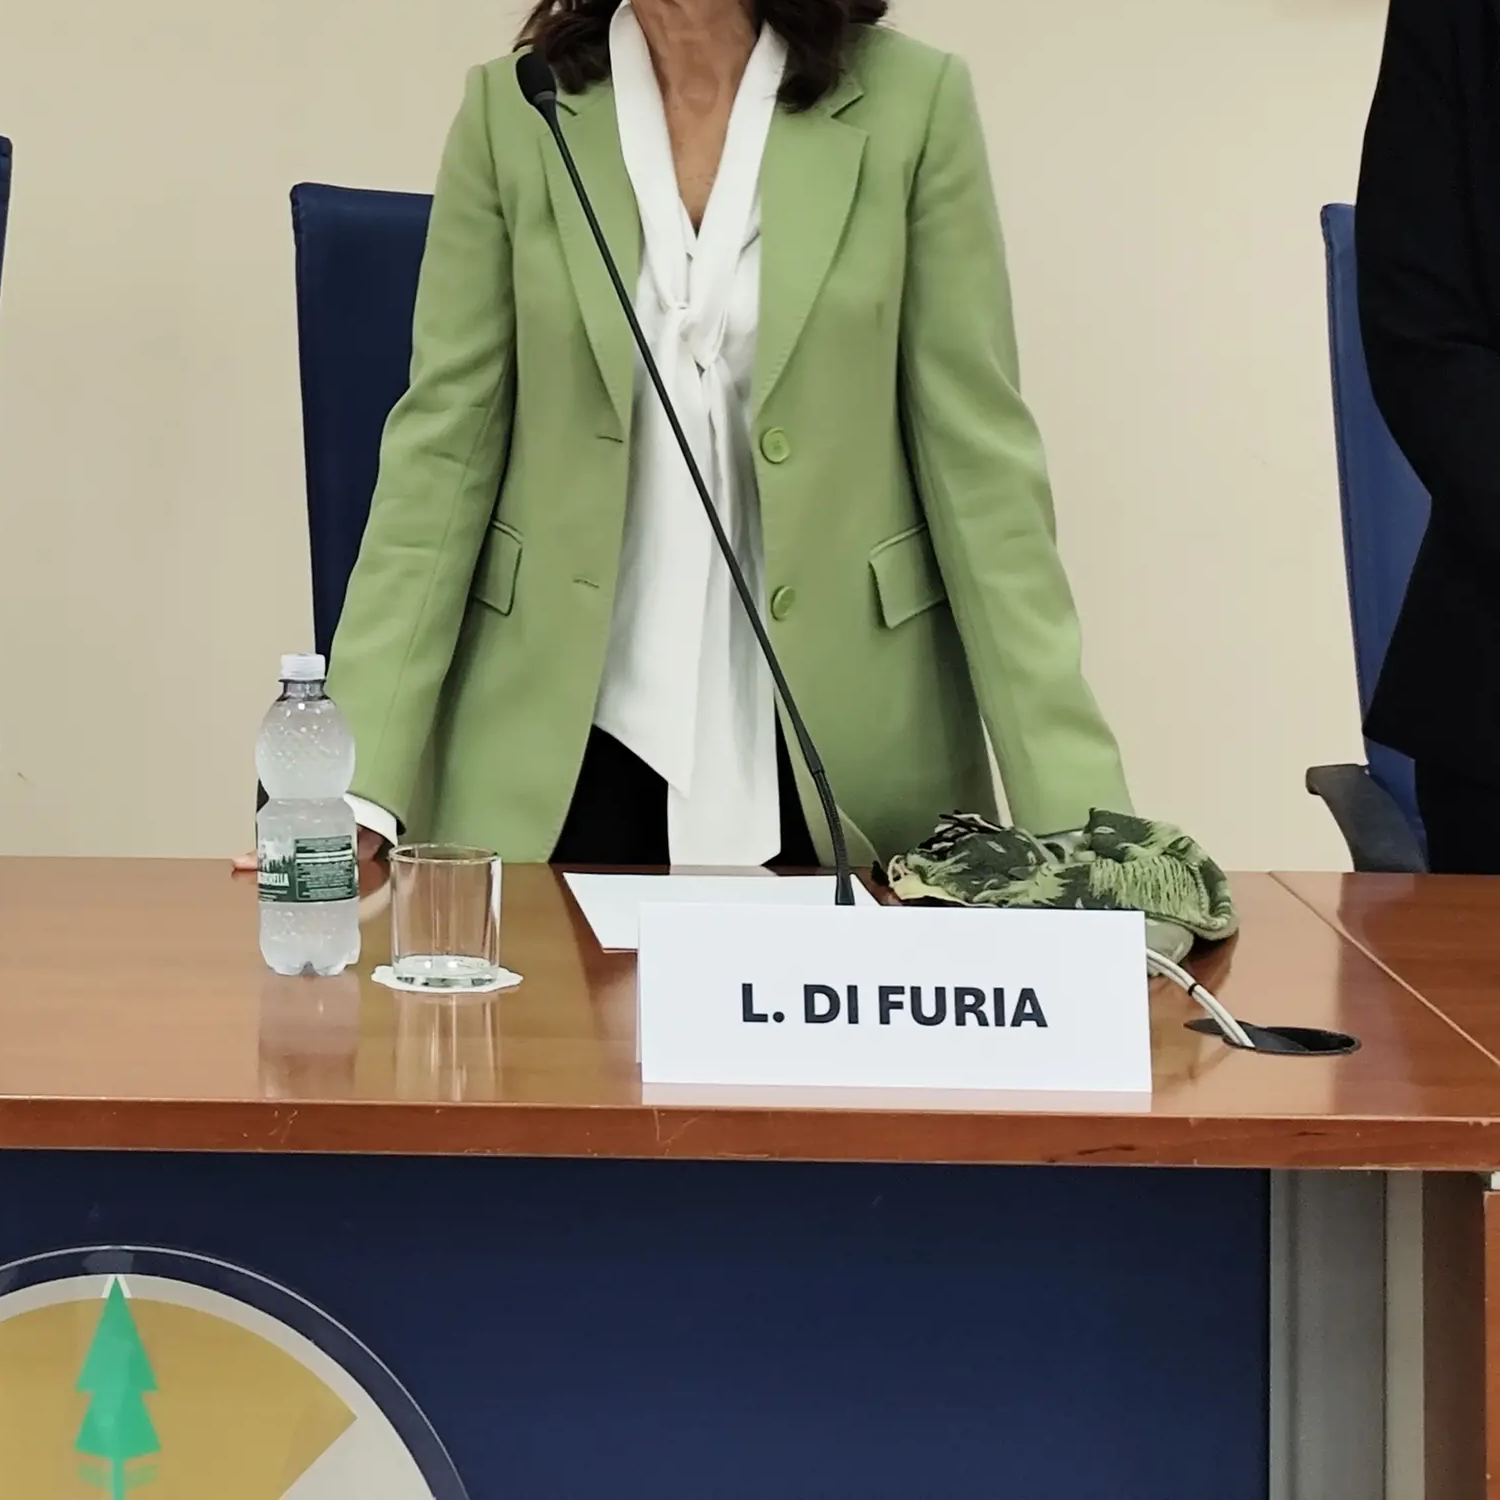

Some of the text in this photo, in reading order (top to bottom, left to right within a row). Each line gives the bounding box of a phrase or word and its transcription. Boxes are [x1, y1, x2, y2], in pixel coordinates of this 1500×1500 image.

[740, 982, 1048, 1028] L. DI FURIA
